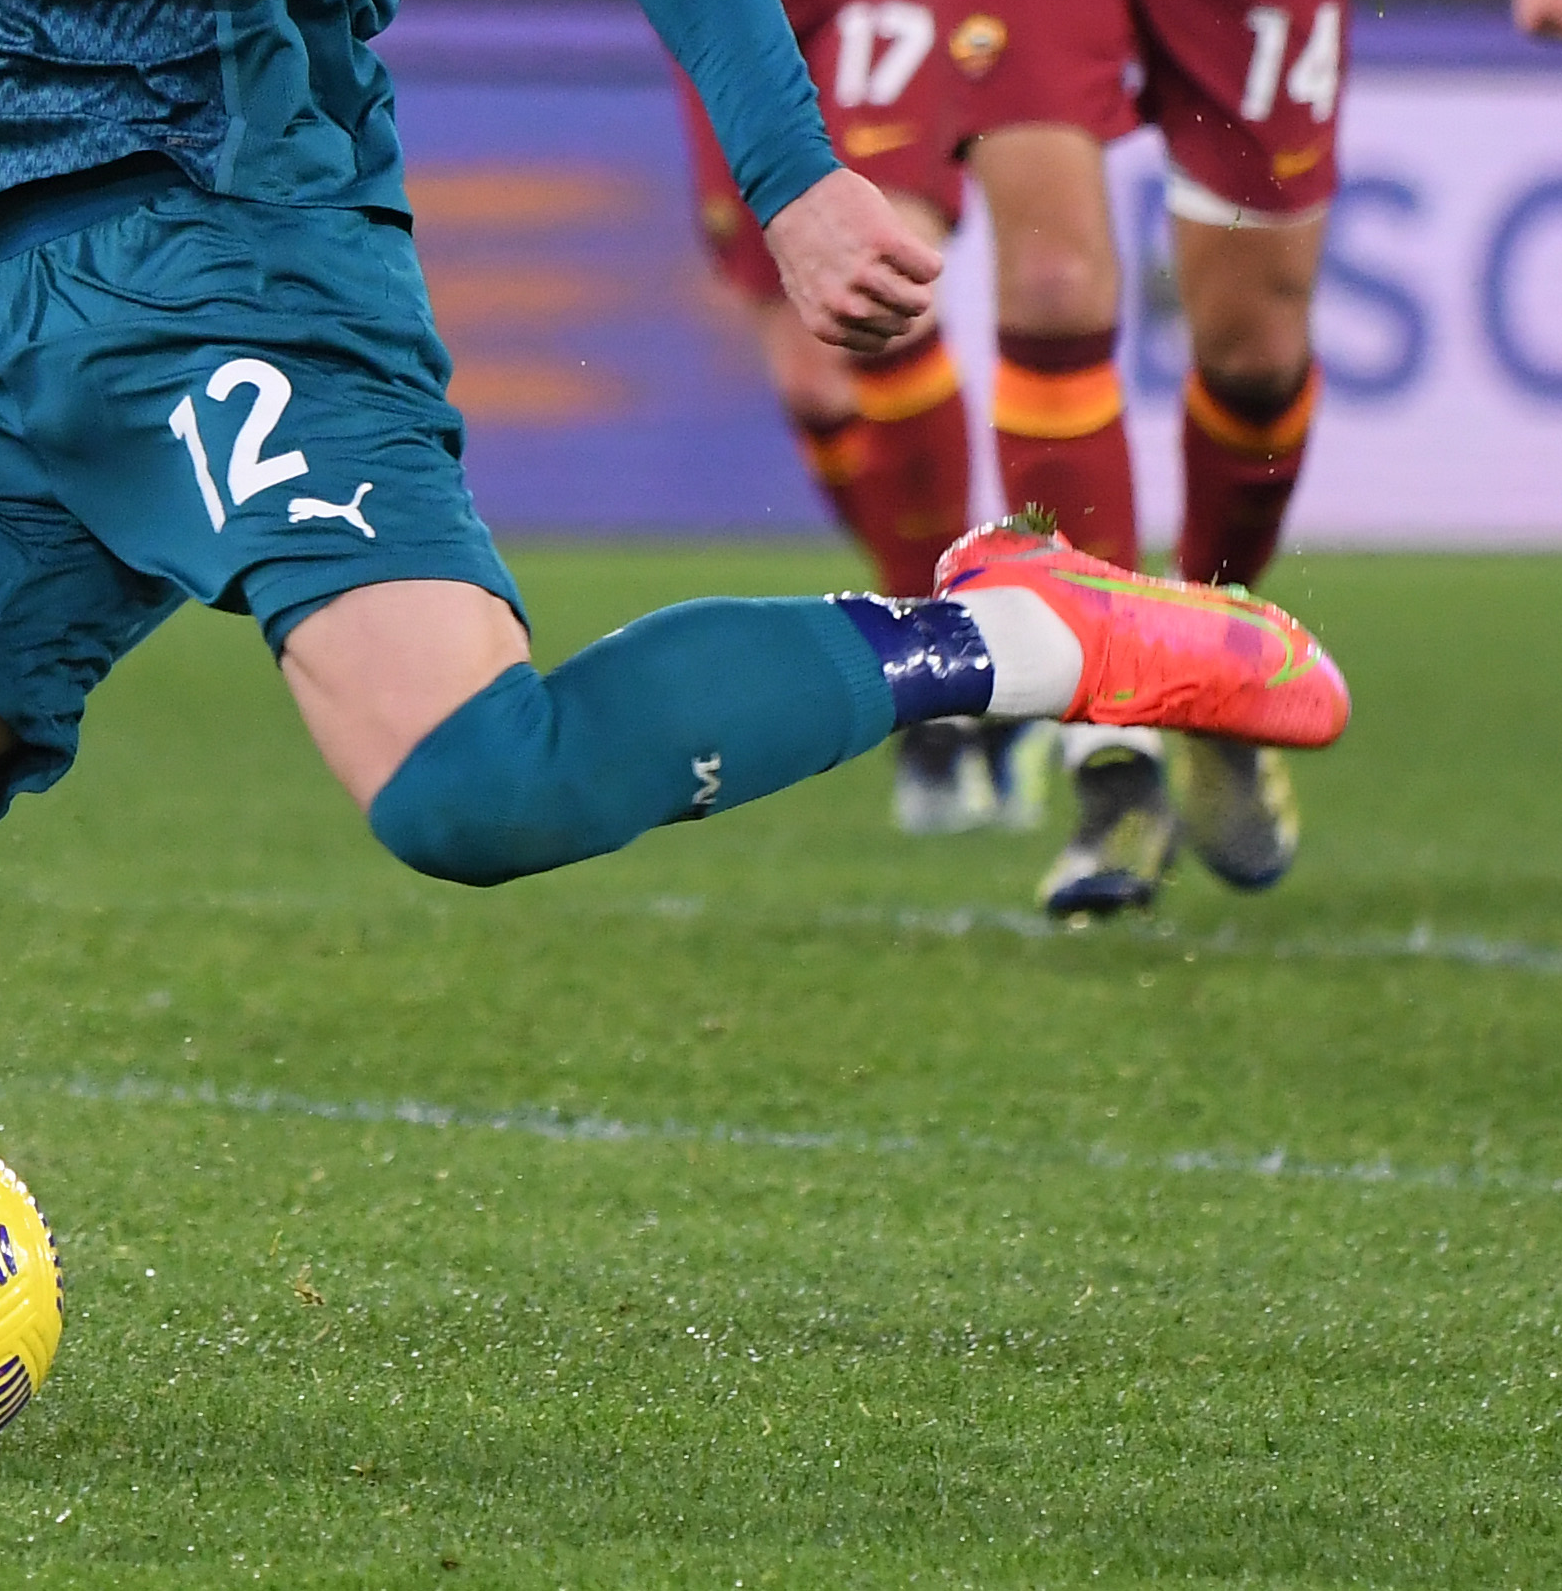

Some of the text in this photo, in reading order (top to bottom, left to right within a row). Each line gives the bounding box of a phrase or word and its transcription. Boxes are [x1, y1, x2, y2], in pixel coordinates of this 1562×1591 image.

[835, 0, 936, 107] 17
[1240, 1, 1340, 123] 14
[167, 358, 310, 534] 12
